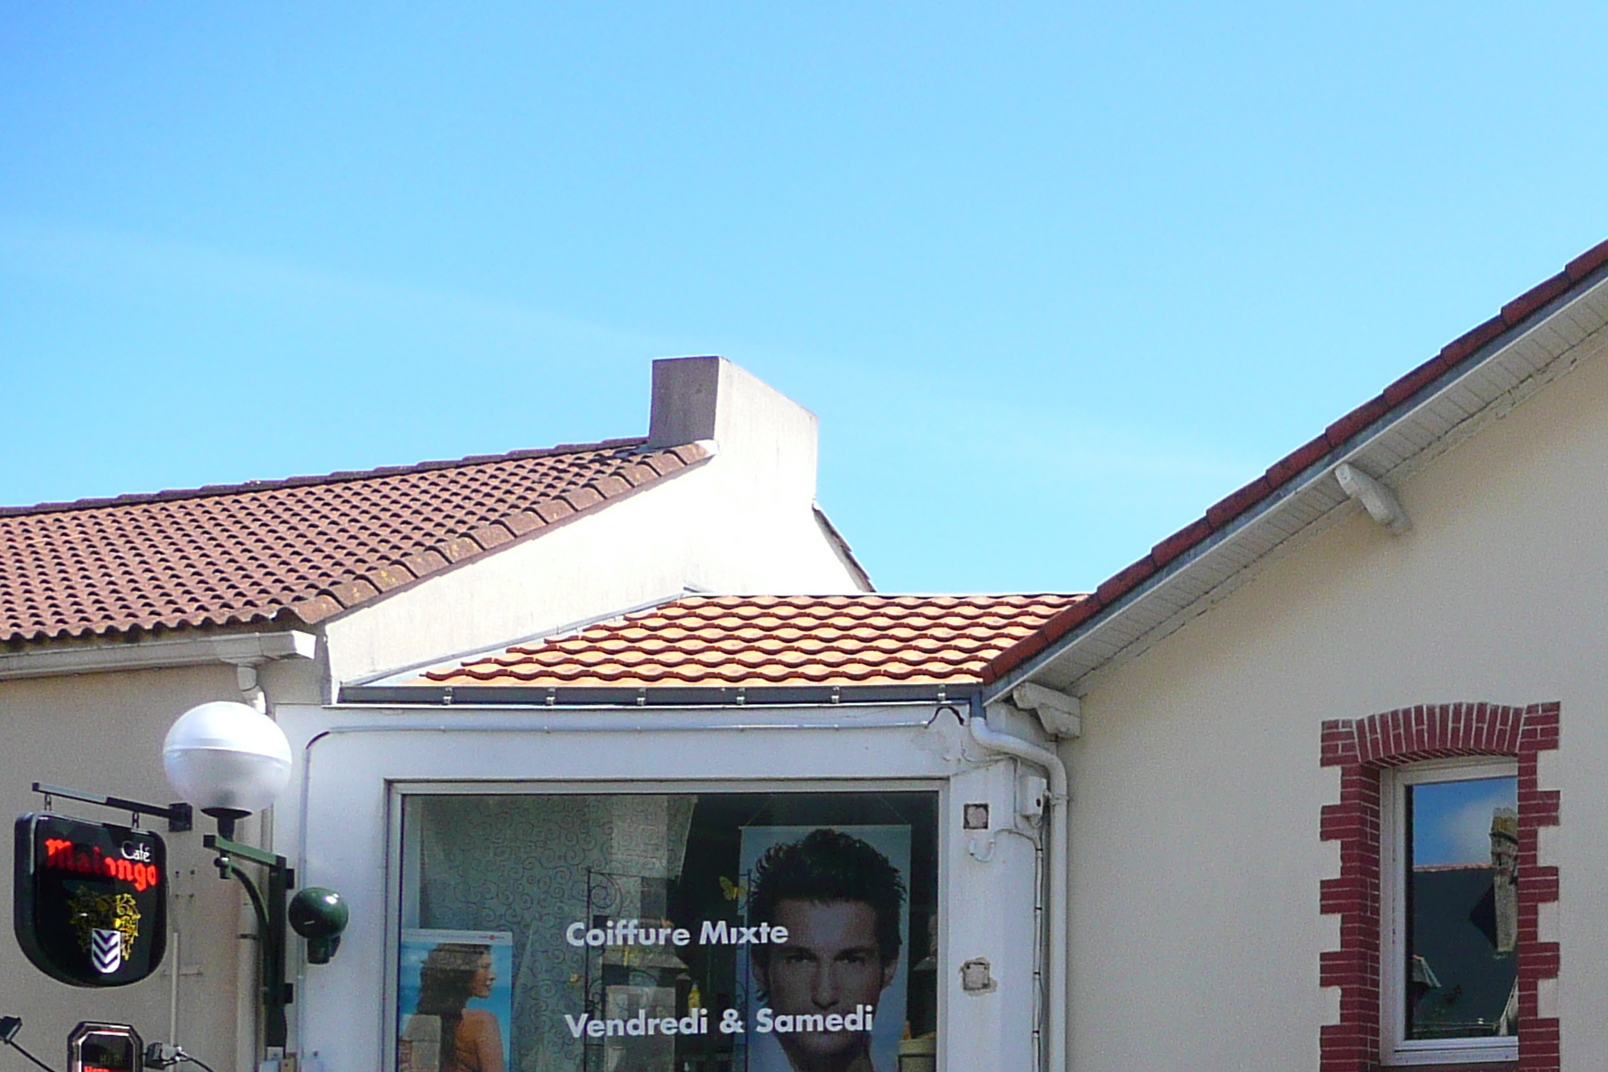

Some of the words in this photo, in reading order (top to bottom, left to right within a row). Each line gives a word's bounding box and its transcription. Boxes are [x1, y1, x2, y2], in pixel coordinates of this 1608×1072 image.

[121, 841, 151, 863] Café
[566, 921, 690, 948] Coiffure
[565, 1010, 709, 1038] Vendredi
[719, 1009, 745, 1034] &
[756, 1004, 874, 1034] Samedi
